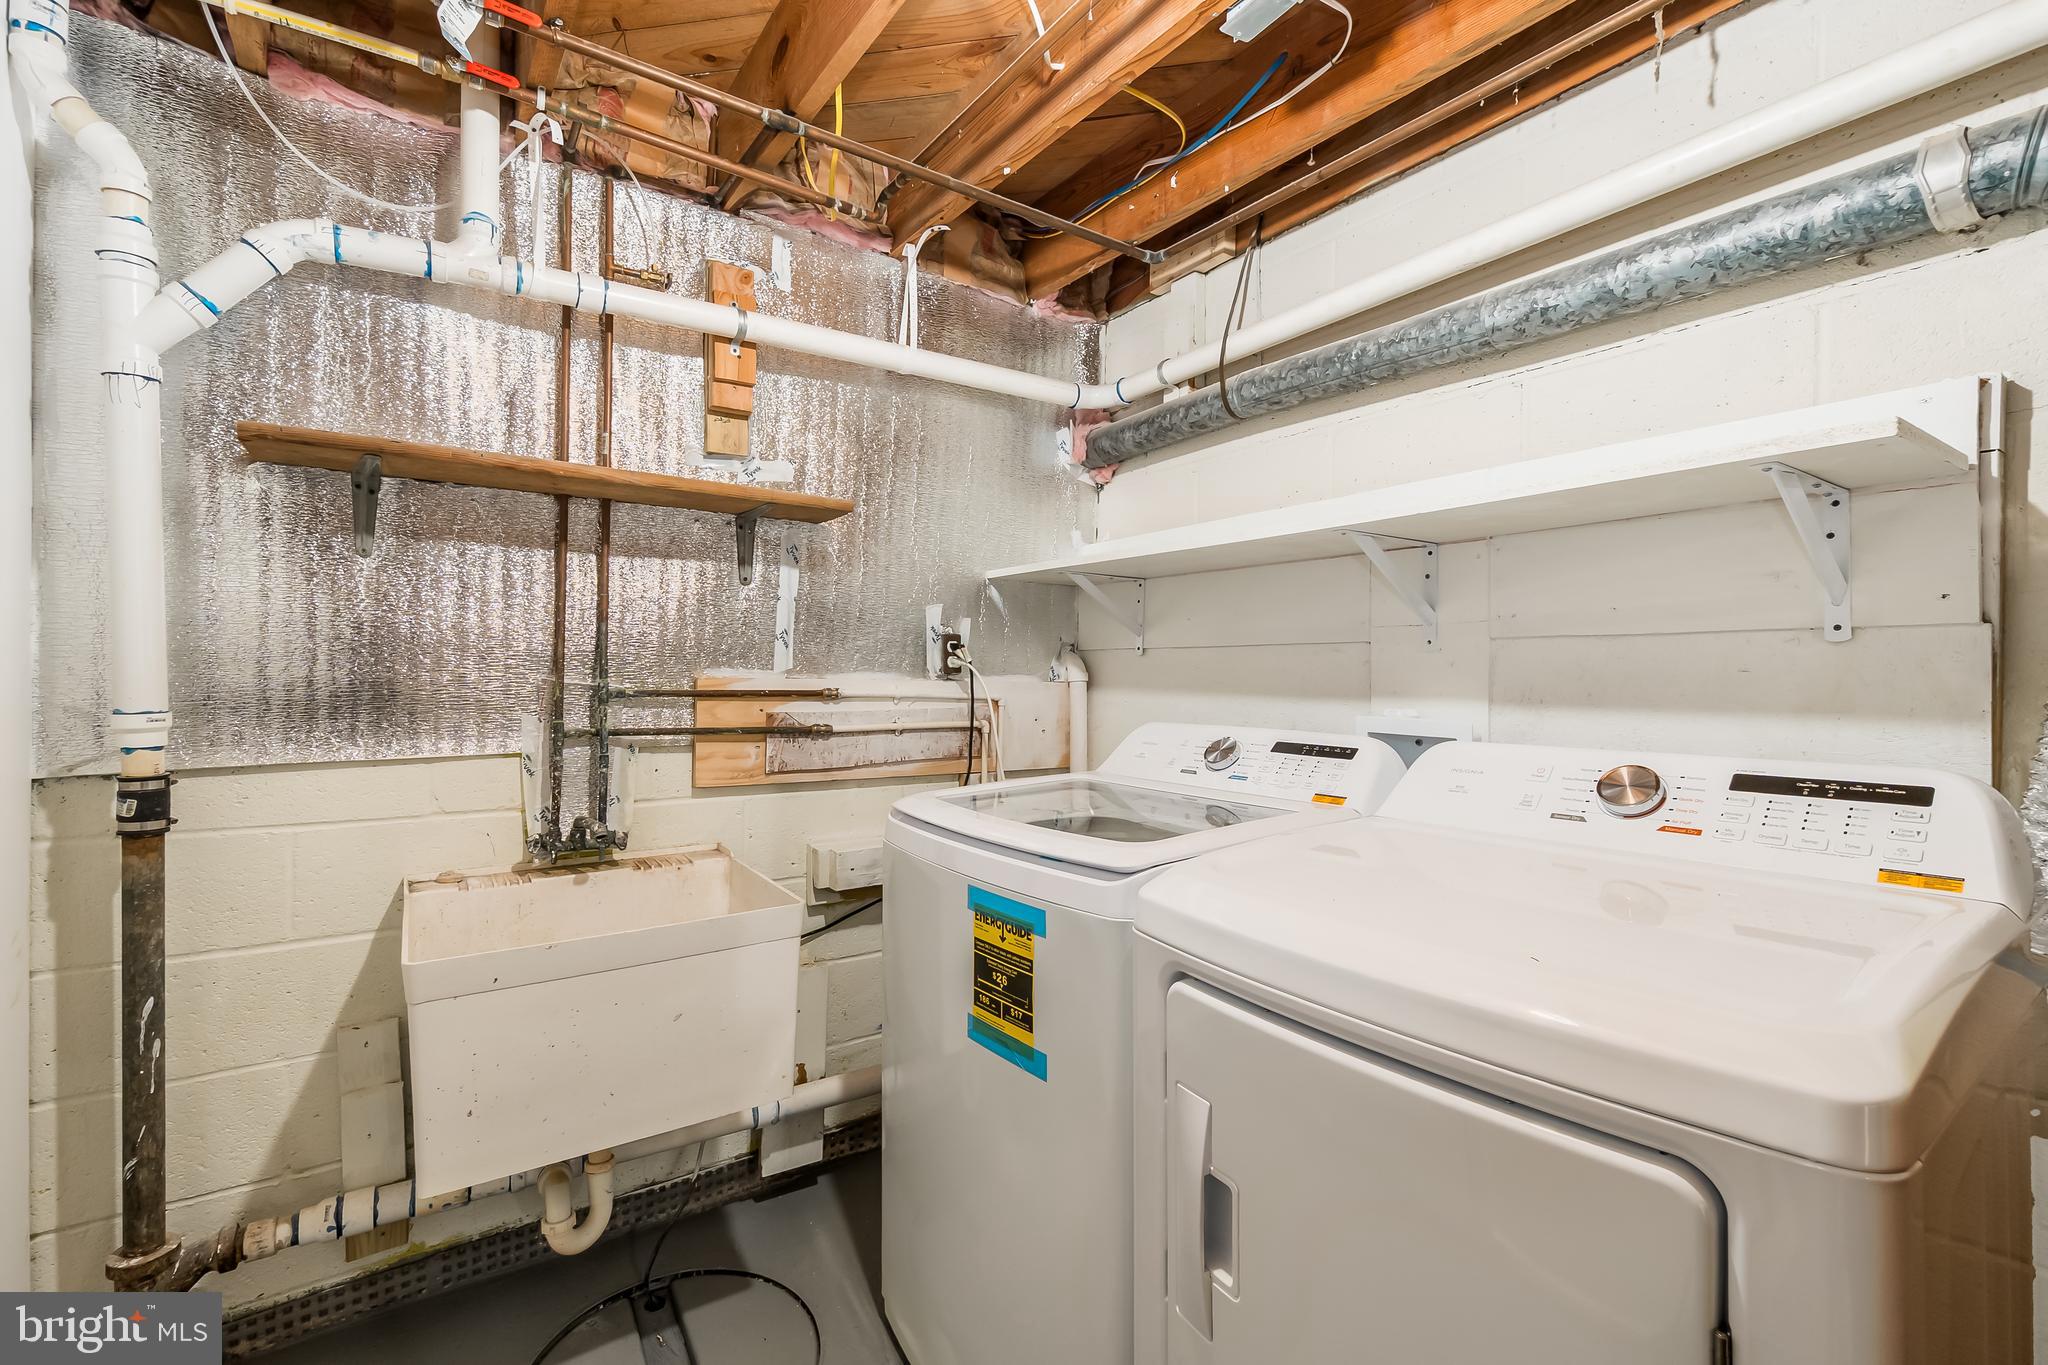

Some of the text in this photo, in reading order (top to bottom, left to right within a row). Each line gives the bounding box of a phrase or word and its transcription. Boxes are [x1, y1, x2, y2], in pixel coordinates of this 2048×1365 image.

[745, 465, 761, 479] Tyvek
[789, 545, 799, 565] Tyvek
[779, 630, 789, 650] Tyvek
[992, 971, 1008, 986] $26
[1010, 1008, 1023, 1020] $17
